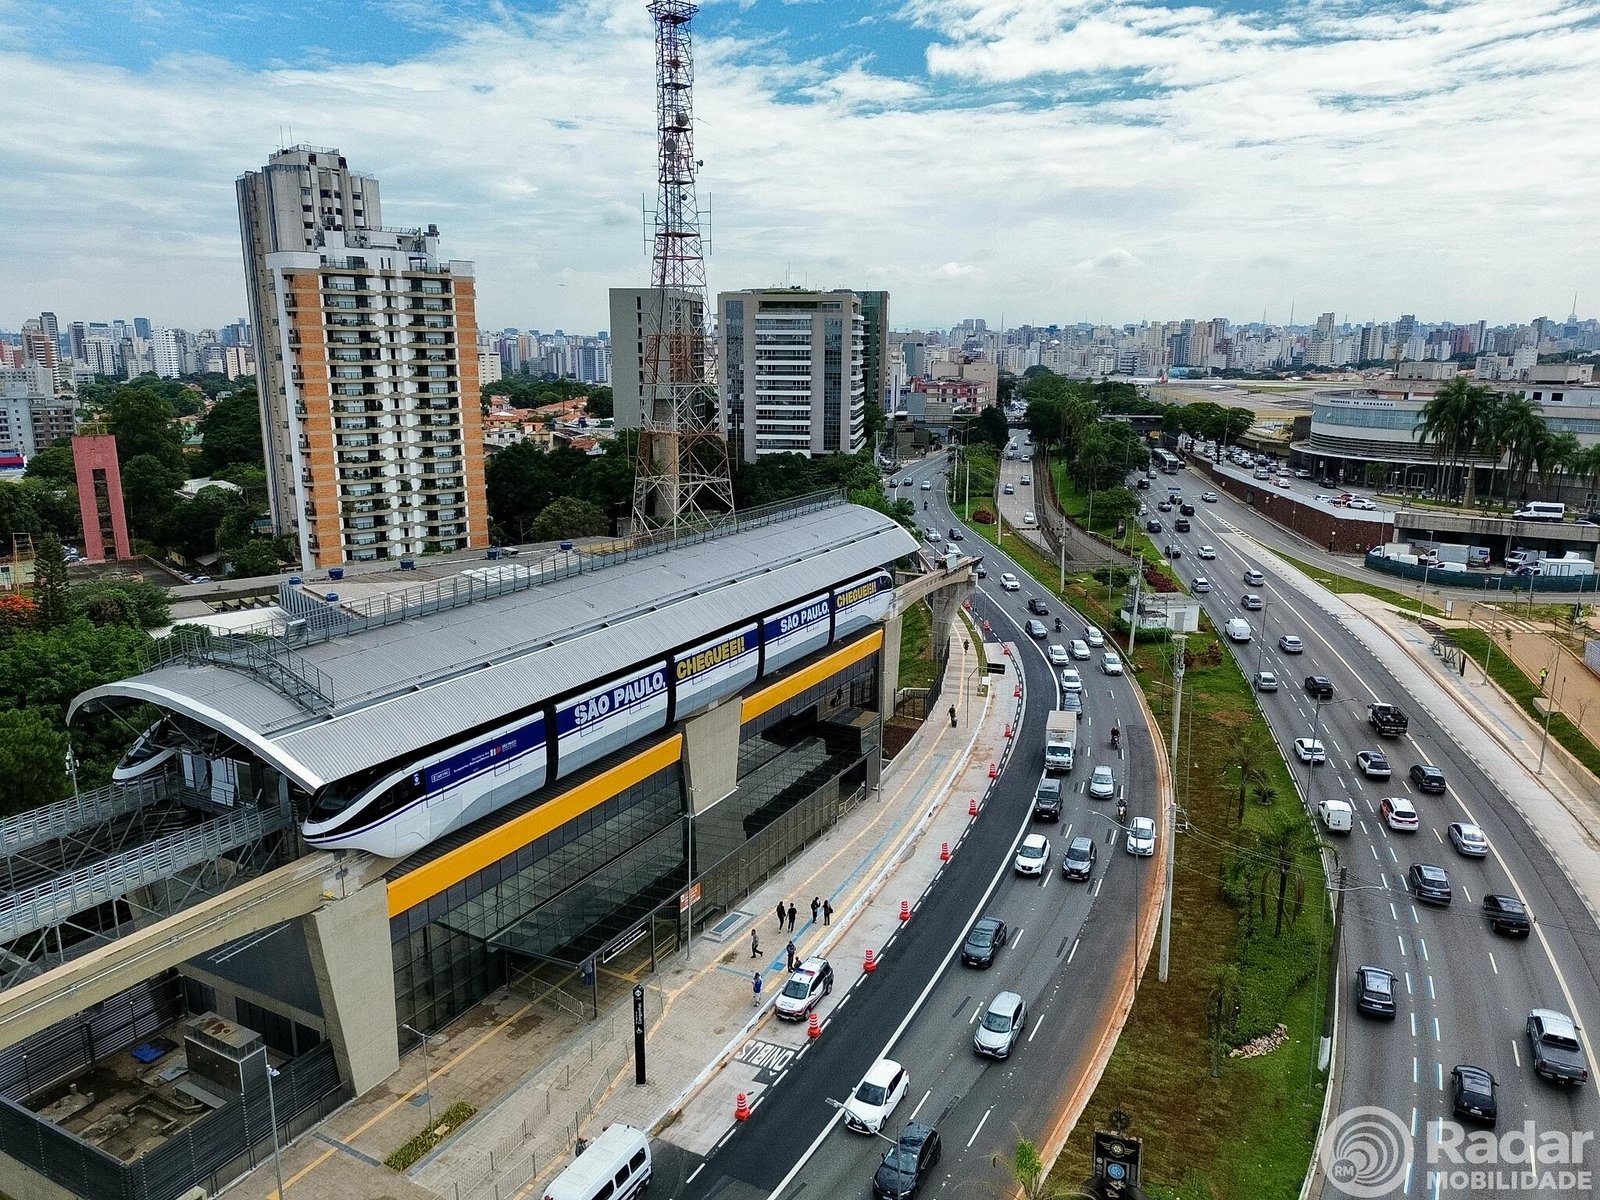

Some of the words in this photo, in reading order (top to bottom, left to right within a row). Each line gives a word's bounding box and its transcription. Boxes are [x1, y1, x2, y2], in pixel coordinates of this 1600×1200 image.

[780, 615, 799, 633] SÃO
[676, 636, 746, 679] CHEGUEEI!
[574, 697, 610, 725] SÃO
[613, 672, 666, 709] PAULO,
